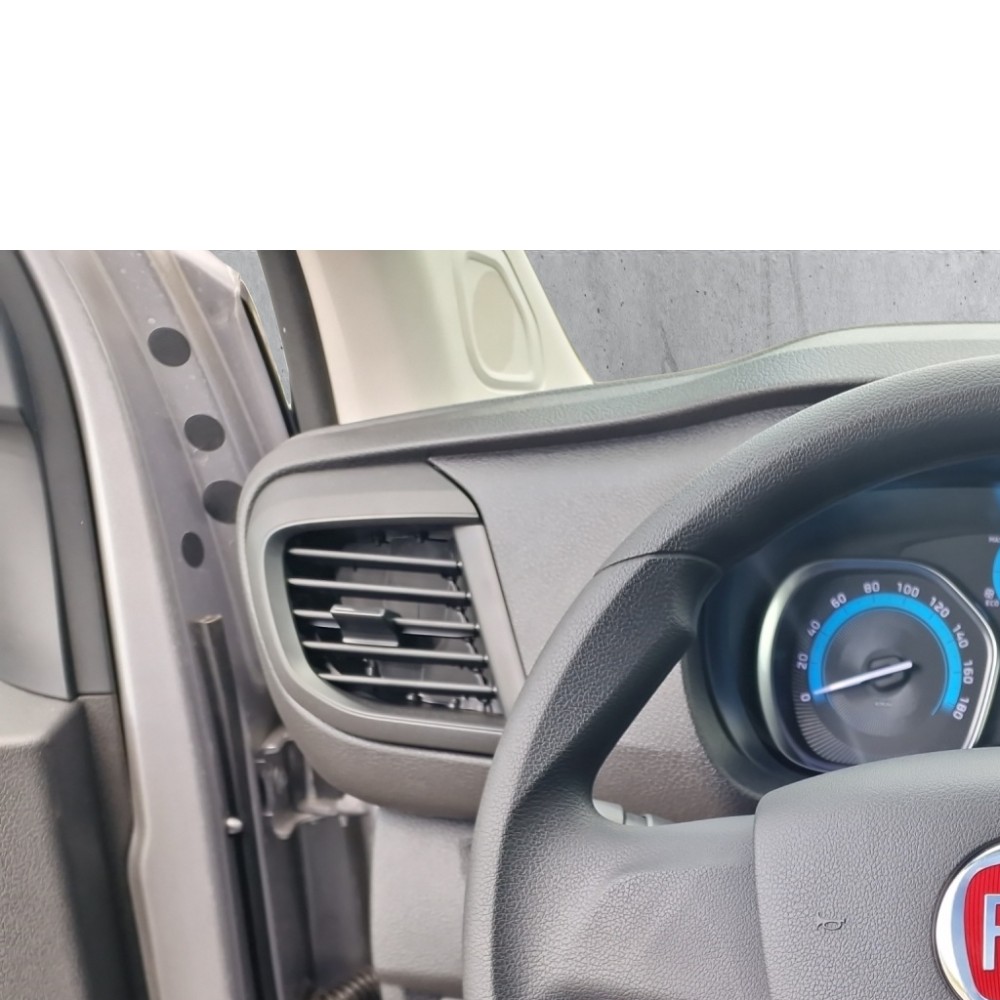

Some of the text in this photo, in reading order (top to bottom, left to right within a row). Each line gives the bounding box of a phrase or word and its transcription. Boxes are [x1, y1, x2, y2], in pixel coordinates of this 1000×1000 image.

[863, 581, 880, 594] 80
[897, 582, 920, 598] 100
[829, 592, 847, 609] 60
[928, 596, 951, 619] 120
[806, 620, 821, 637] 40
[952, 624, 969, 649] 140
[797, 652, 809, 670] 20
[963, 659, 974, 685] 160
[800, 692, 812, 702] 0
[952, 698, 969, 720] 180
